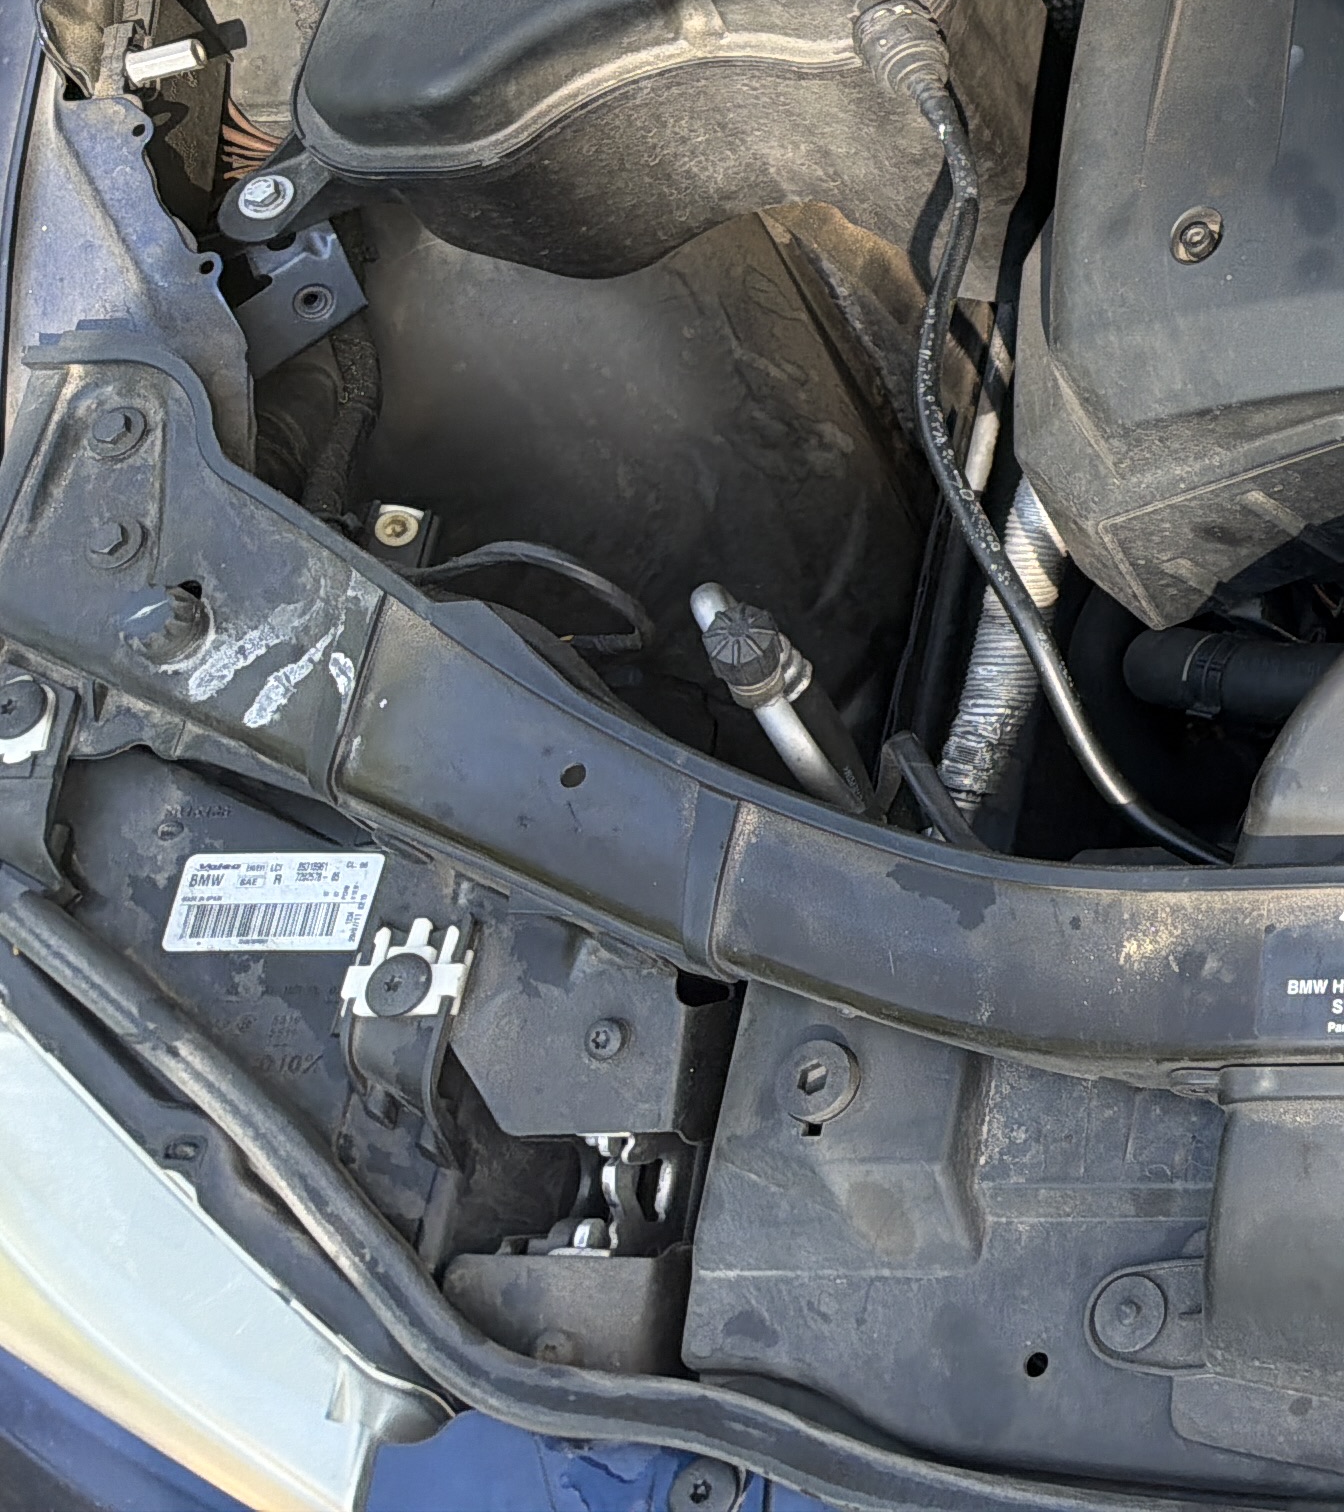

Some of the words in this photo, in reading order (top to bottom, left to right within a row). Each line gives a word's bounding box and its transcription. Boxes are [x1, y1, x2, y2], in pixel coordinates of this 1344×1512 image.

[189, 873, 225, 887] BMW
[273, 874, 283, 885] R
[1287, 980, 1328, 994] BMW
